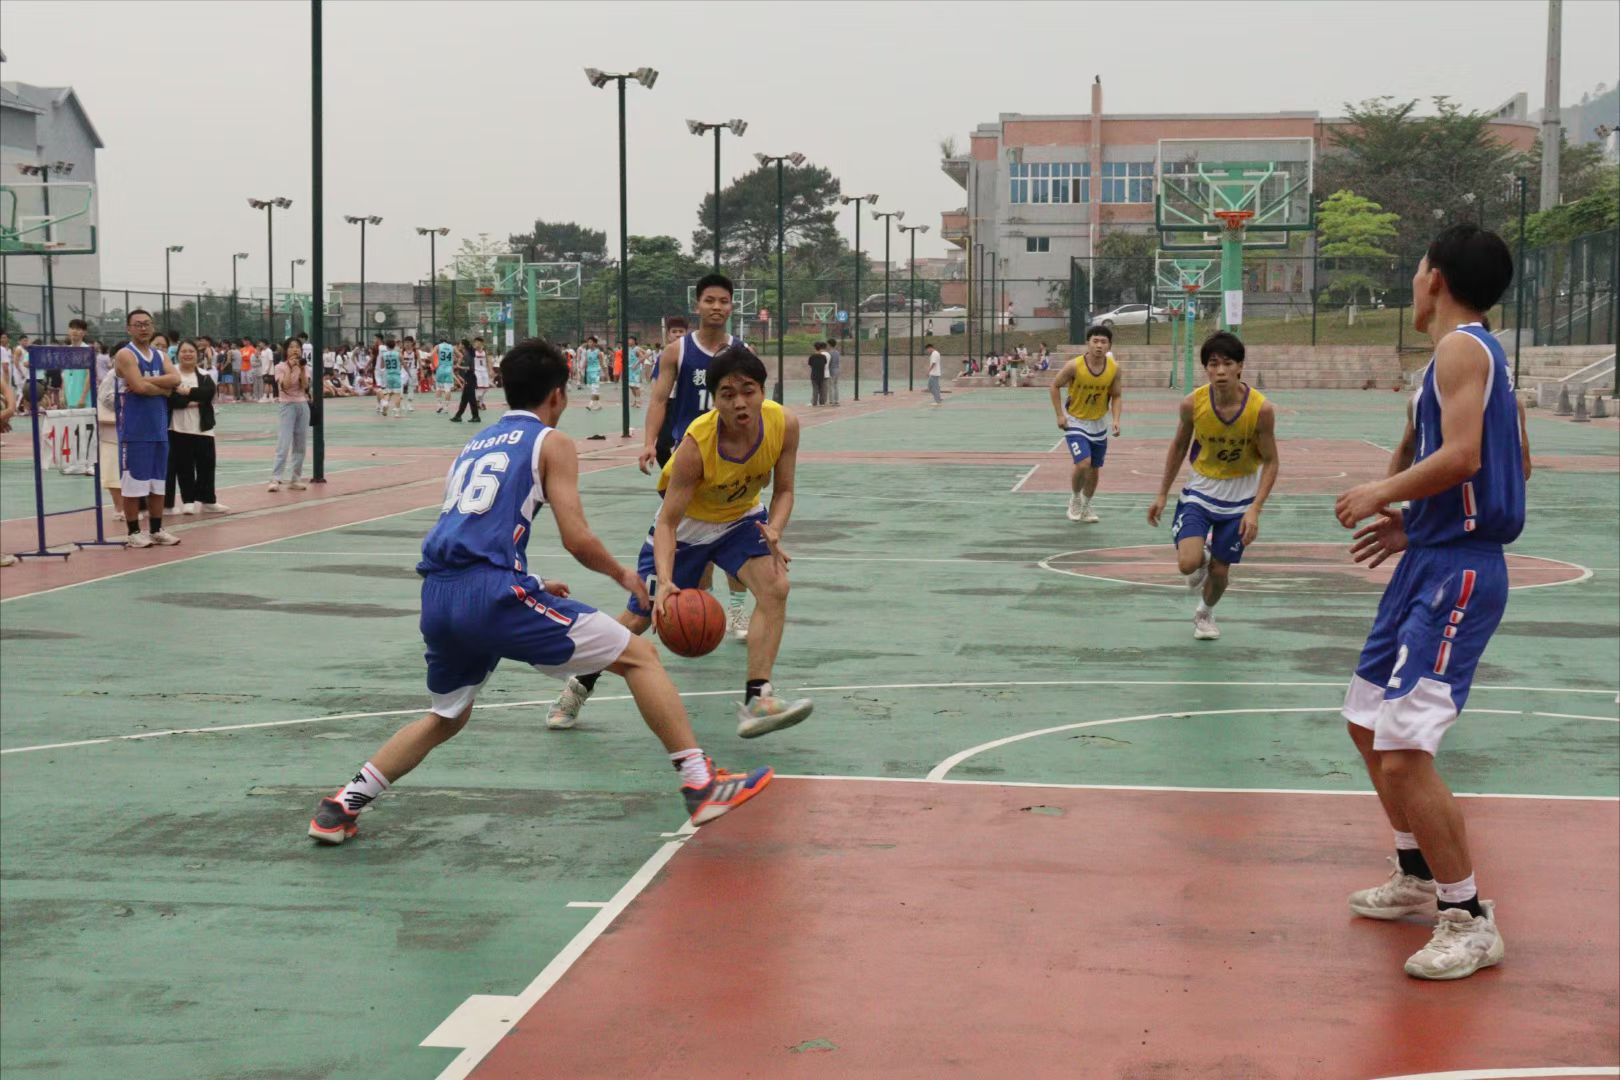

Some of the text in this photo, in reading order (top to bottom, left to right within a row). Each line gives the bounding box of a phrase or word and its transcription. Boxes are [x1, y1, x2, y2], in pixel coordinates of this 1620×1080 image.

[385, 358, 398, 370] 23
[439, 351, 452, 362] 34
[74, 423, 95, 461] 17
[459, 430, 525, 457] Huang
[1070, 441, 1082, 456] 2
[1217, 448, 1243, 464] 65
